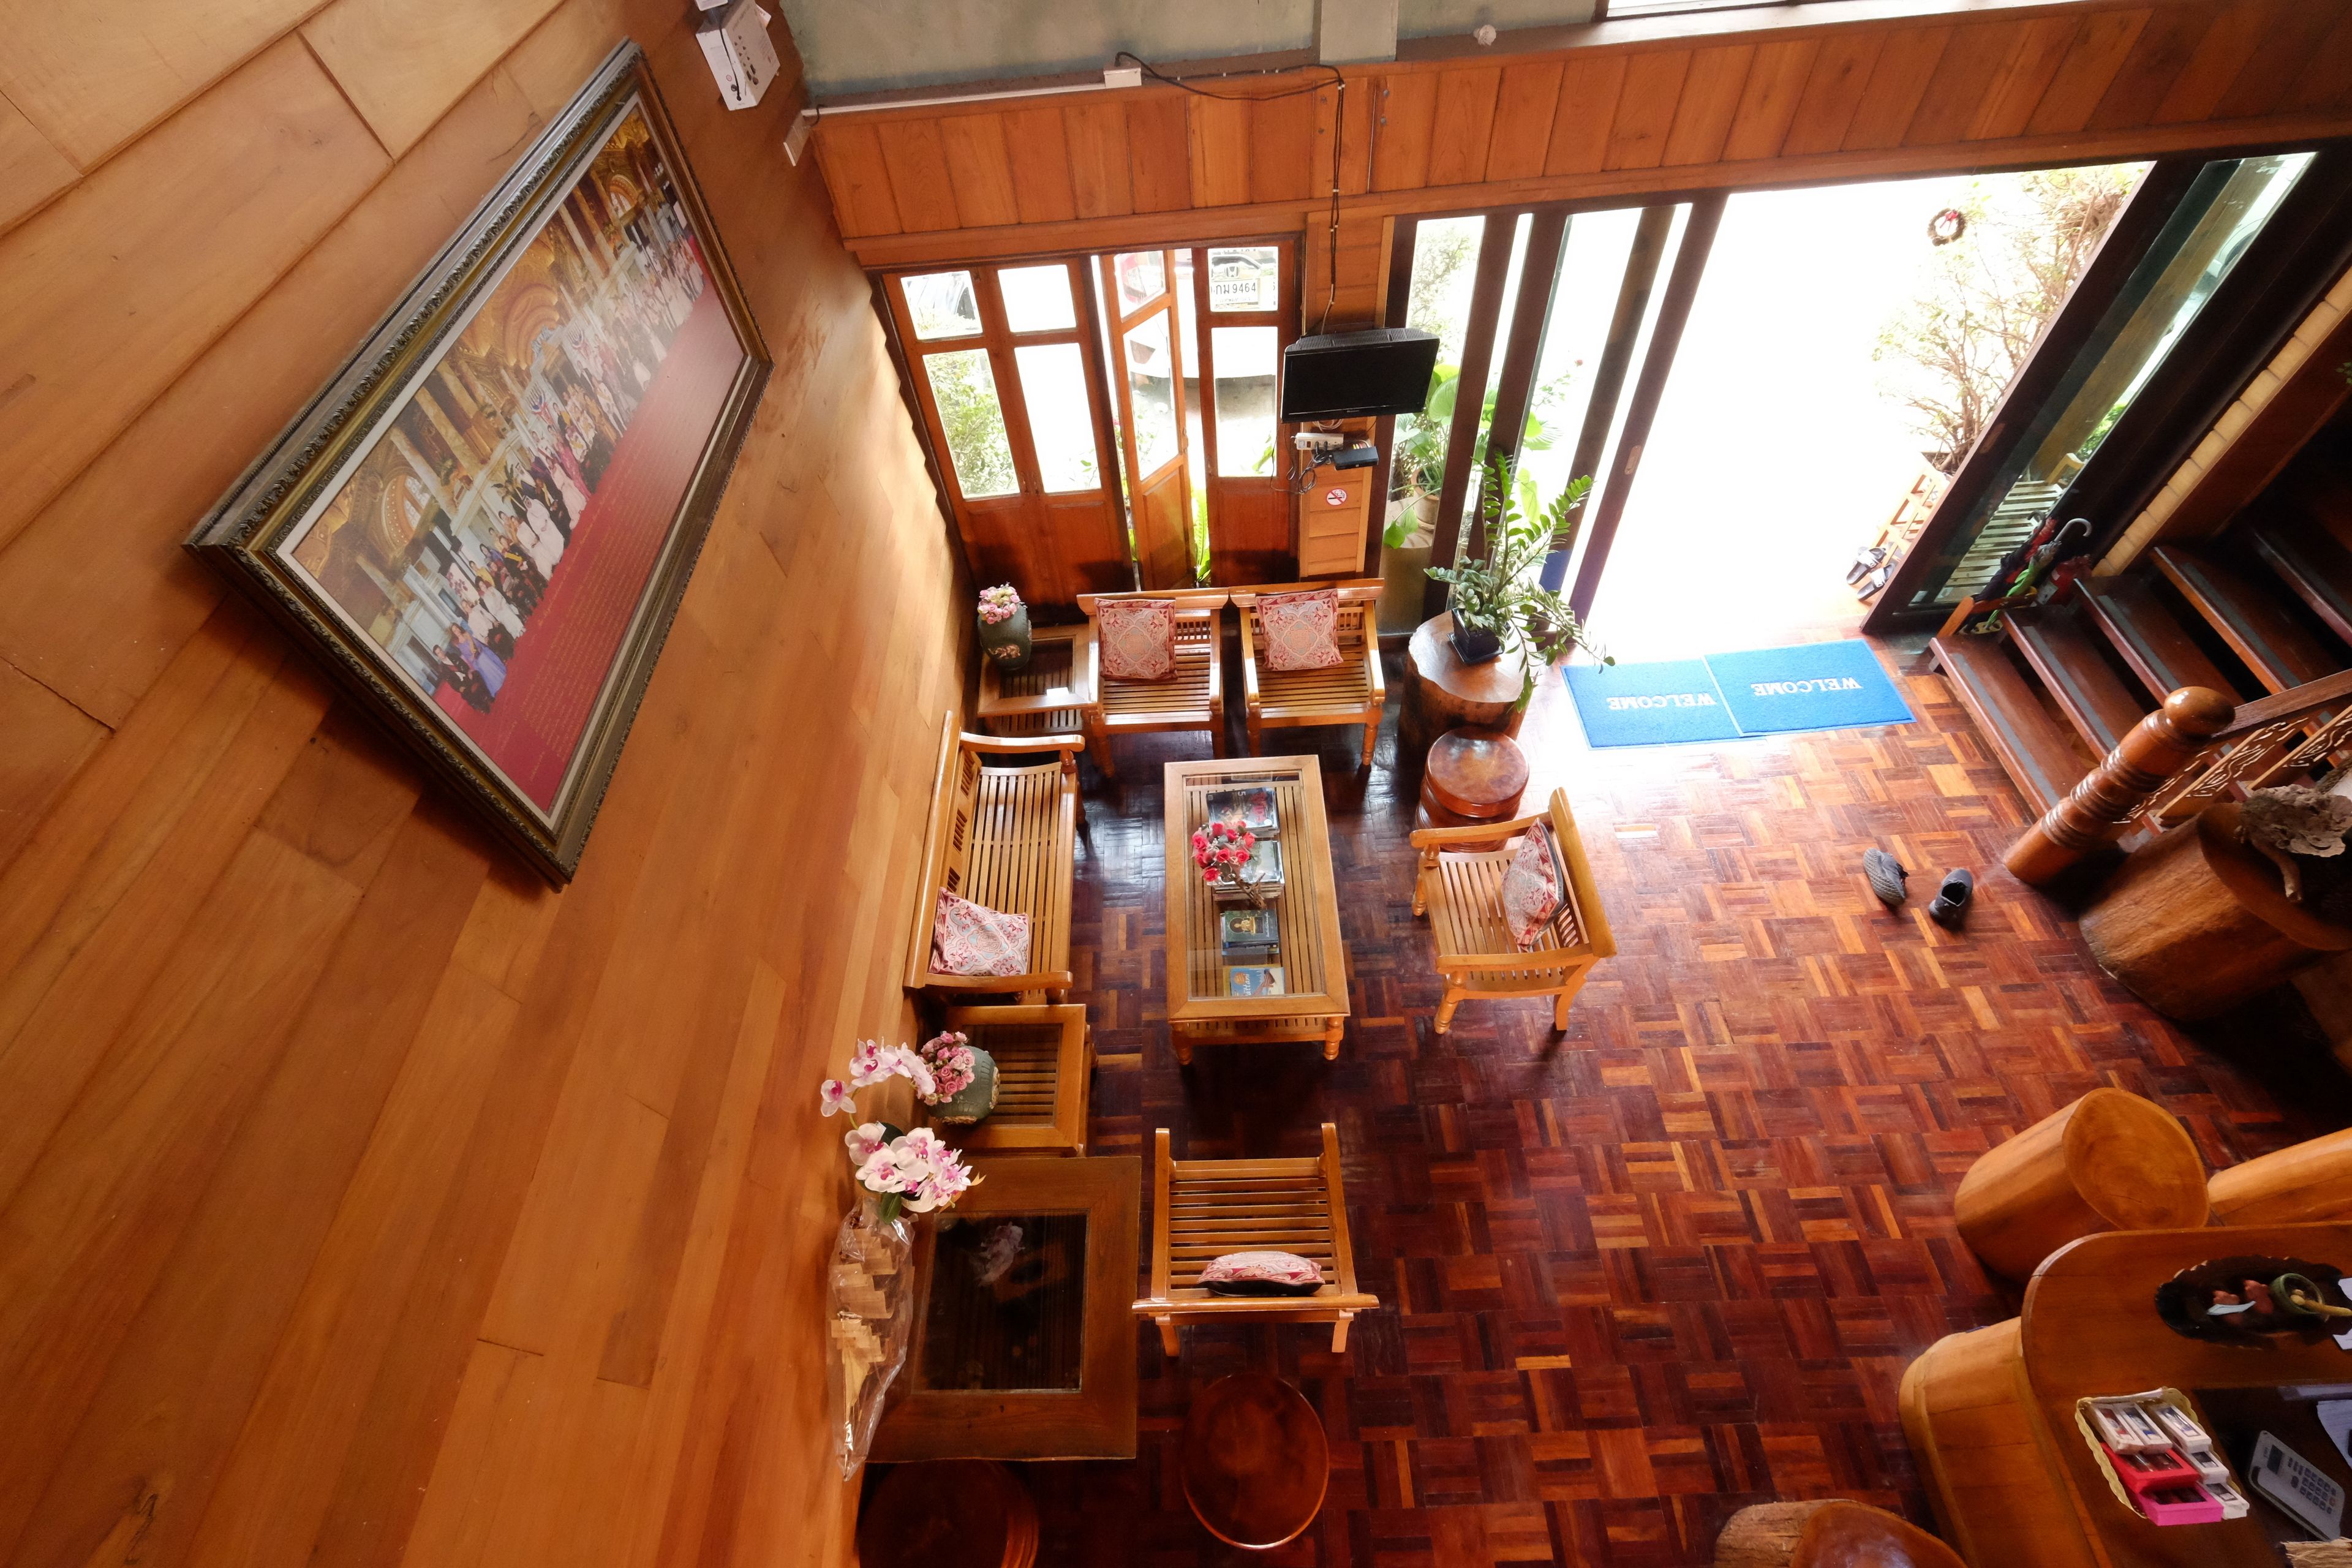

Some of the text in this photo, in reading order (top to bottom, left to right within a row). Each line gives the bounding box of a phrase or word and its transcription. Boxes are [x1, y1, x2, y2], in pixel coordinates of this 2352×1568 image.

[1232, 282, 1256, 293] 9464
[1752, 677, 1862, 696] WELCOME
[1608, 693, 1717, 710] WELCOME
[1243, 973, 1251, 996] attani
